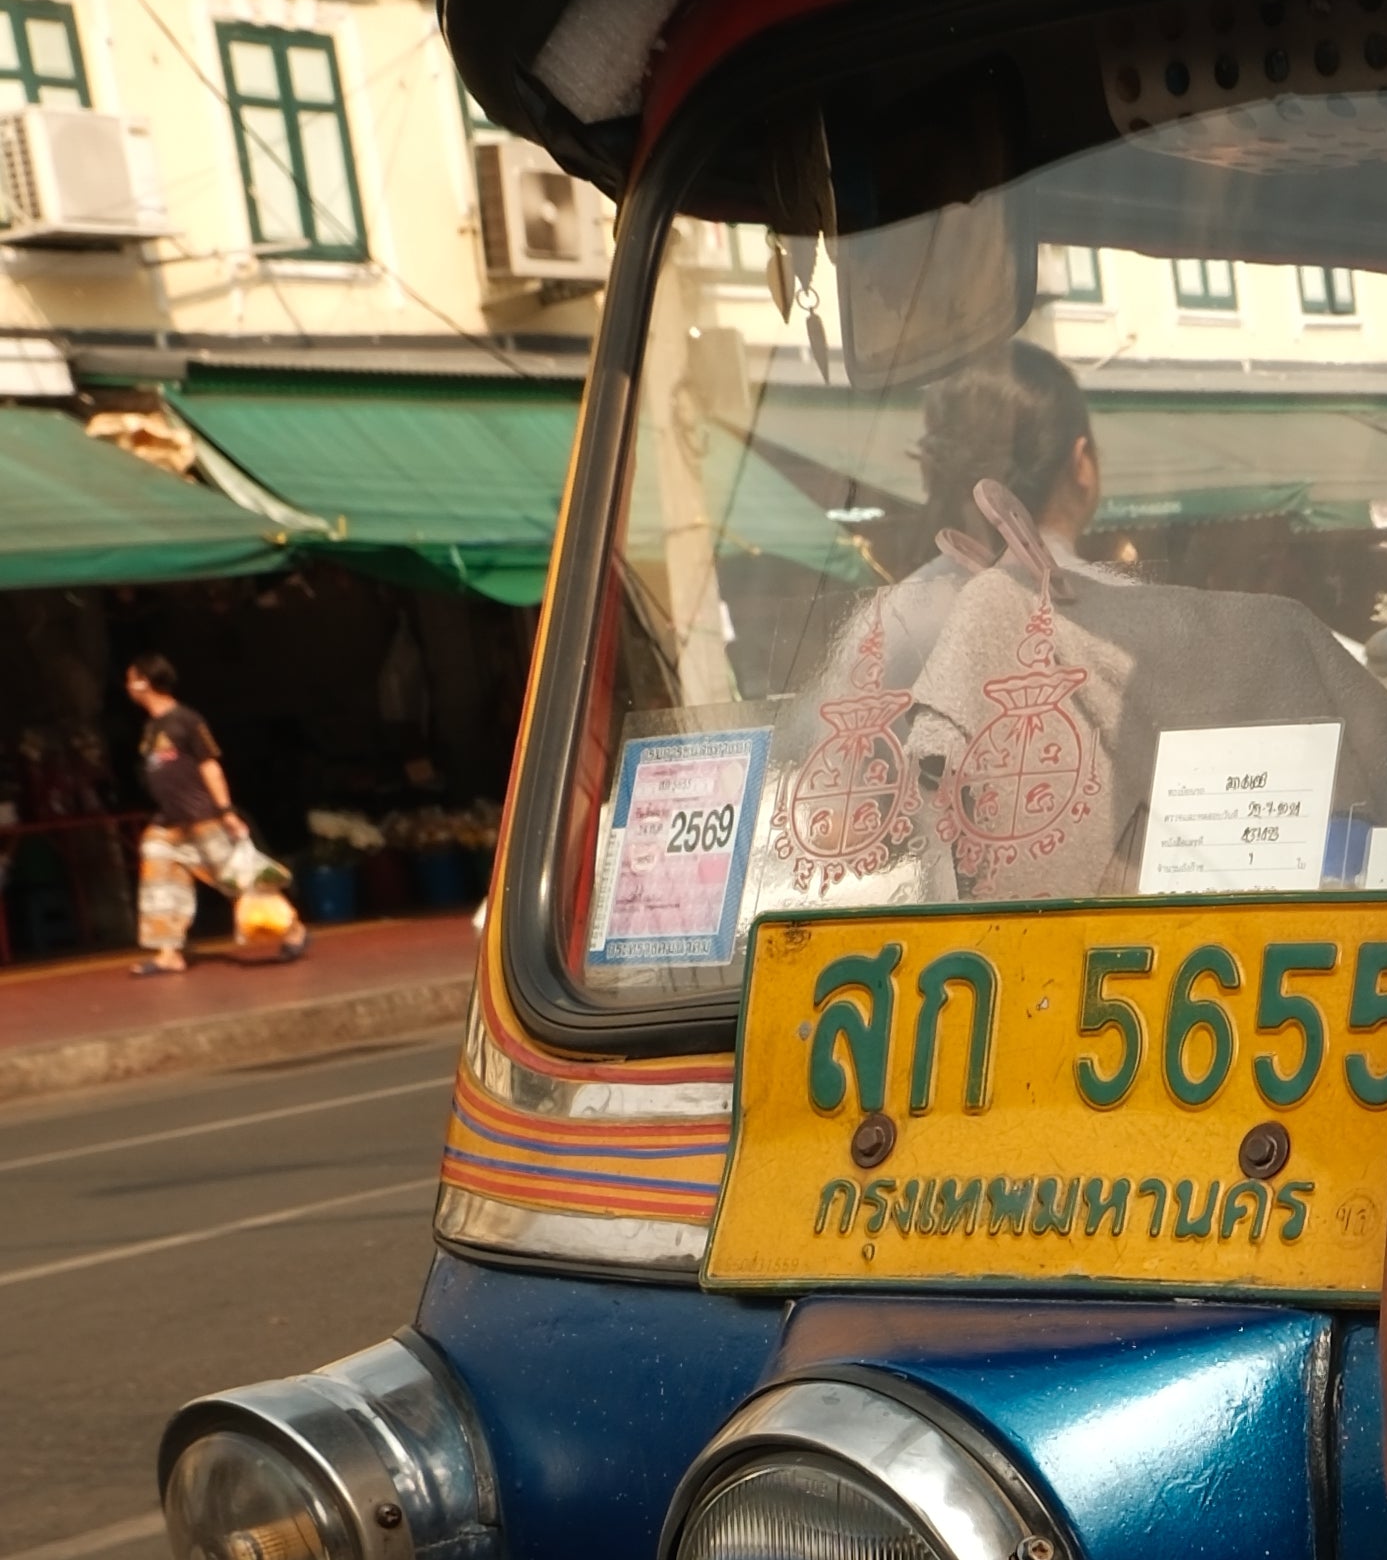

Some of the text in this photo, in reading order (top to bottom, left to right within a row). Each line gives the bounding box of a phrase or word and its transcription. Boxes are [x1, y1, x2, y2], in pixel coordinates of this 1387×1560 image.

[667, 804, 735, 853] 2569
[807, 941, 1000, 1115] สก
[815, 1175, 1316, 1264] กรุงเทพมหานคร
